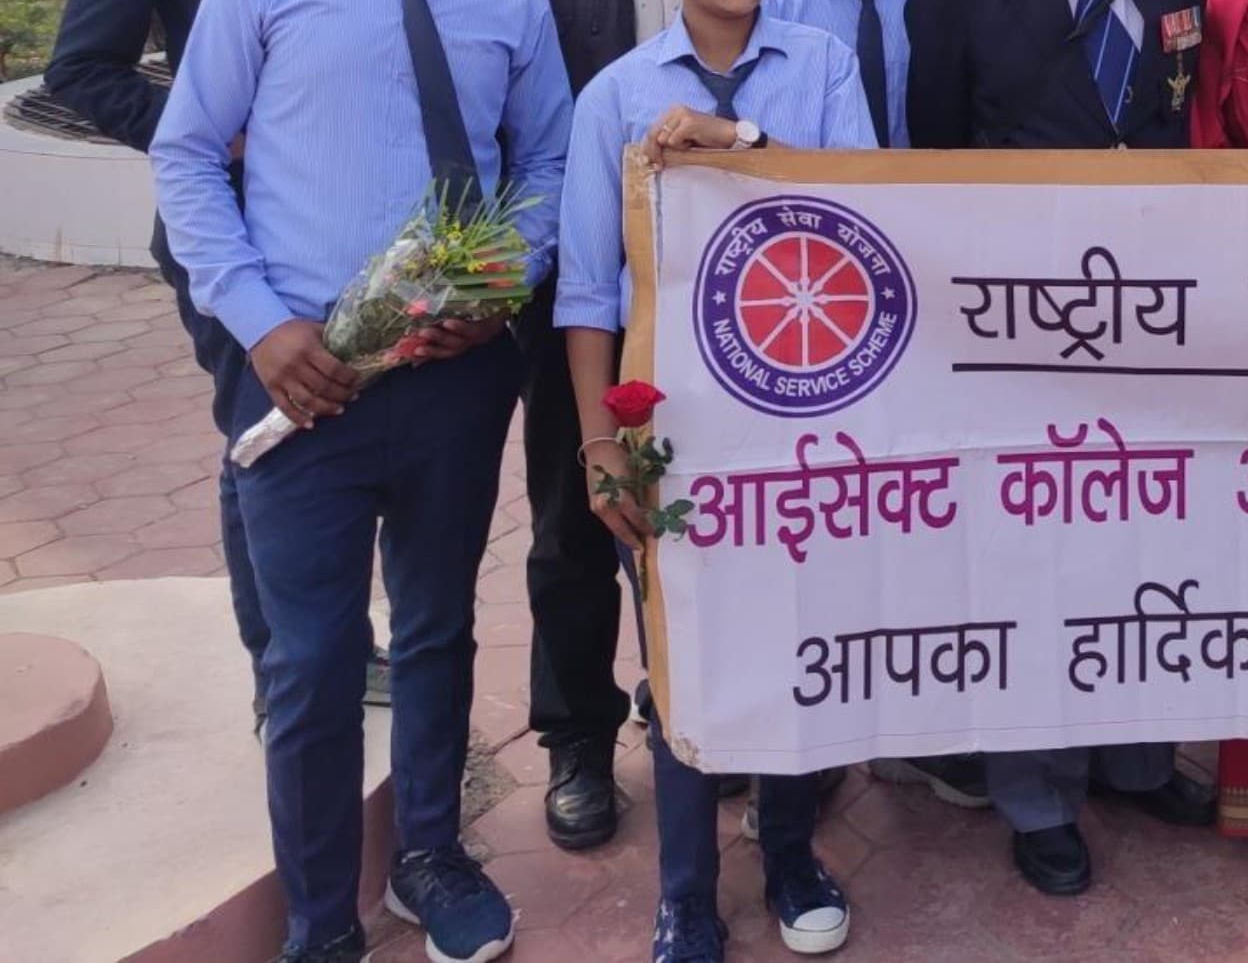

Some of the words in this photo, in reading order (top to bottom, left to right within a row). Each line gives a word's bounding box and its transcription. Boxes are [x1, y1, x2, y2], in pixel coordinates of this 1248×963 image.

[715, 217, 768, 276] राष्ट्रीय
[776, 206, 822, 230] सेवा
[837, 222, 892, 277] योजना
[951, 245, 1198, 361] राष्ट्रीय
[712, 318, 771, 391] NATIONAL
[773, 371, 851, 398] SERVICE
[849, 310, 897, 376] SCHEME
[687, 431, 960, 564] आईसेक्ट
[997, 417, 1195, 526] कॉलेज
[792, 620, 1018, 707] आपका
